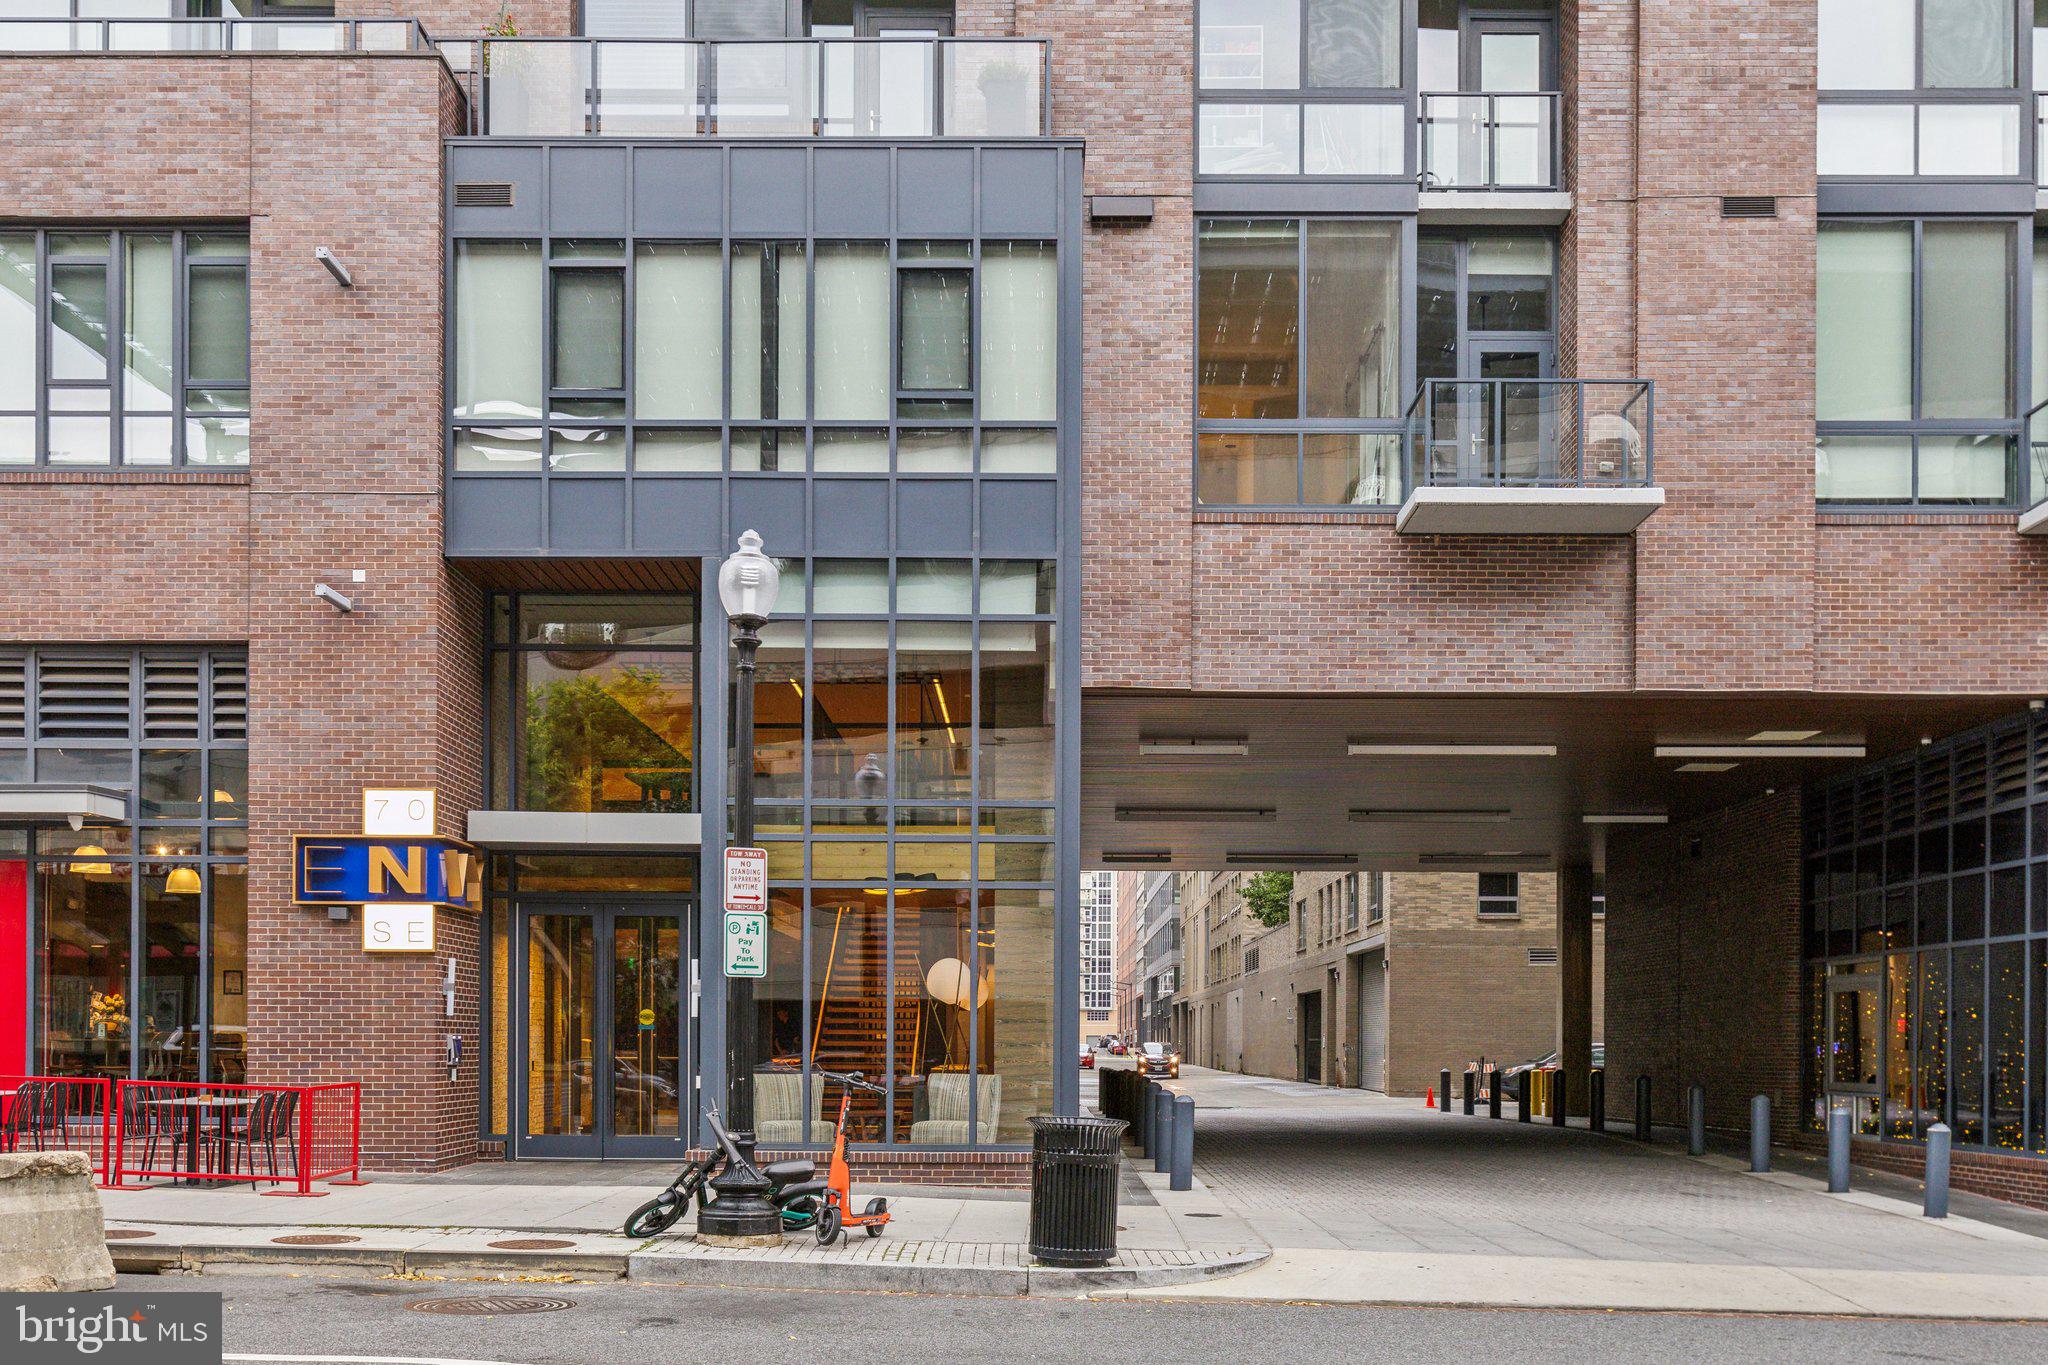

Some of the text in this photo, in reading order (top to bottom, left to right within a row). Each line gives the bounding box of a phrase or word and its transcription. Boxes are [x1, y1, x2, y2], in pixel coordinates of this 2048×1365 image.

[374, 799, 425, 821] 70
[373, 921, 424, 942] SE
[738, 938, 753, 946] Pay
